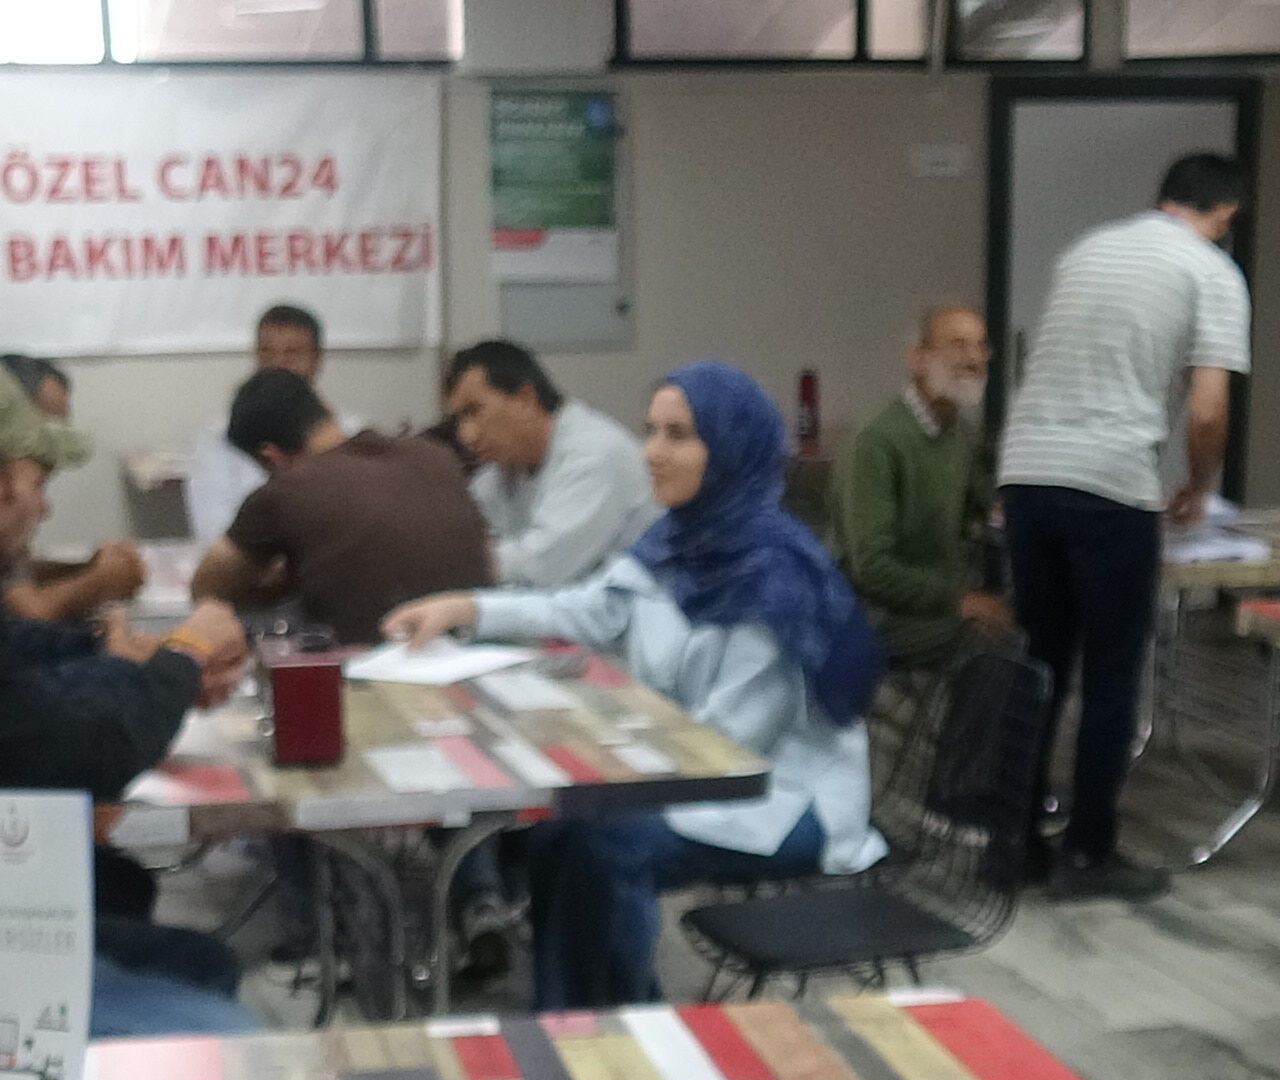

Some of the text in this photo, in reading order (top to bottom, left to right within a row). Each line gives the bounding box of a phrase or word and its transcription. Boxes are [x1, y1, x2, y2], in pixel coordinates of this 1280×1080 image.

[155, 151, 340, 202] CAN24
[5, 223, 438, 282] BAKIM MERKEZİ
